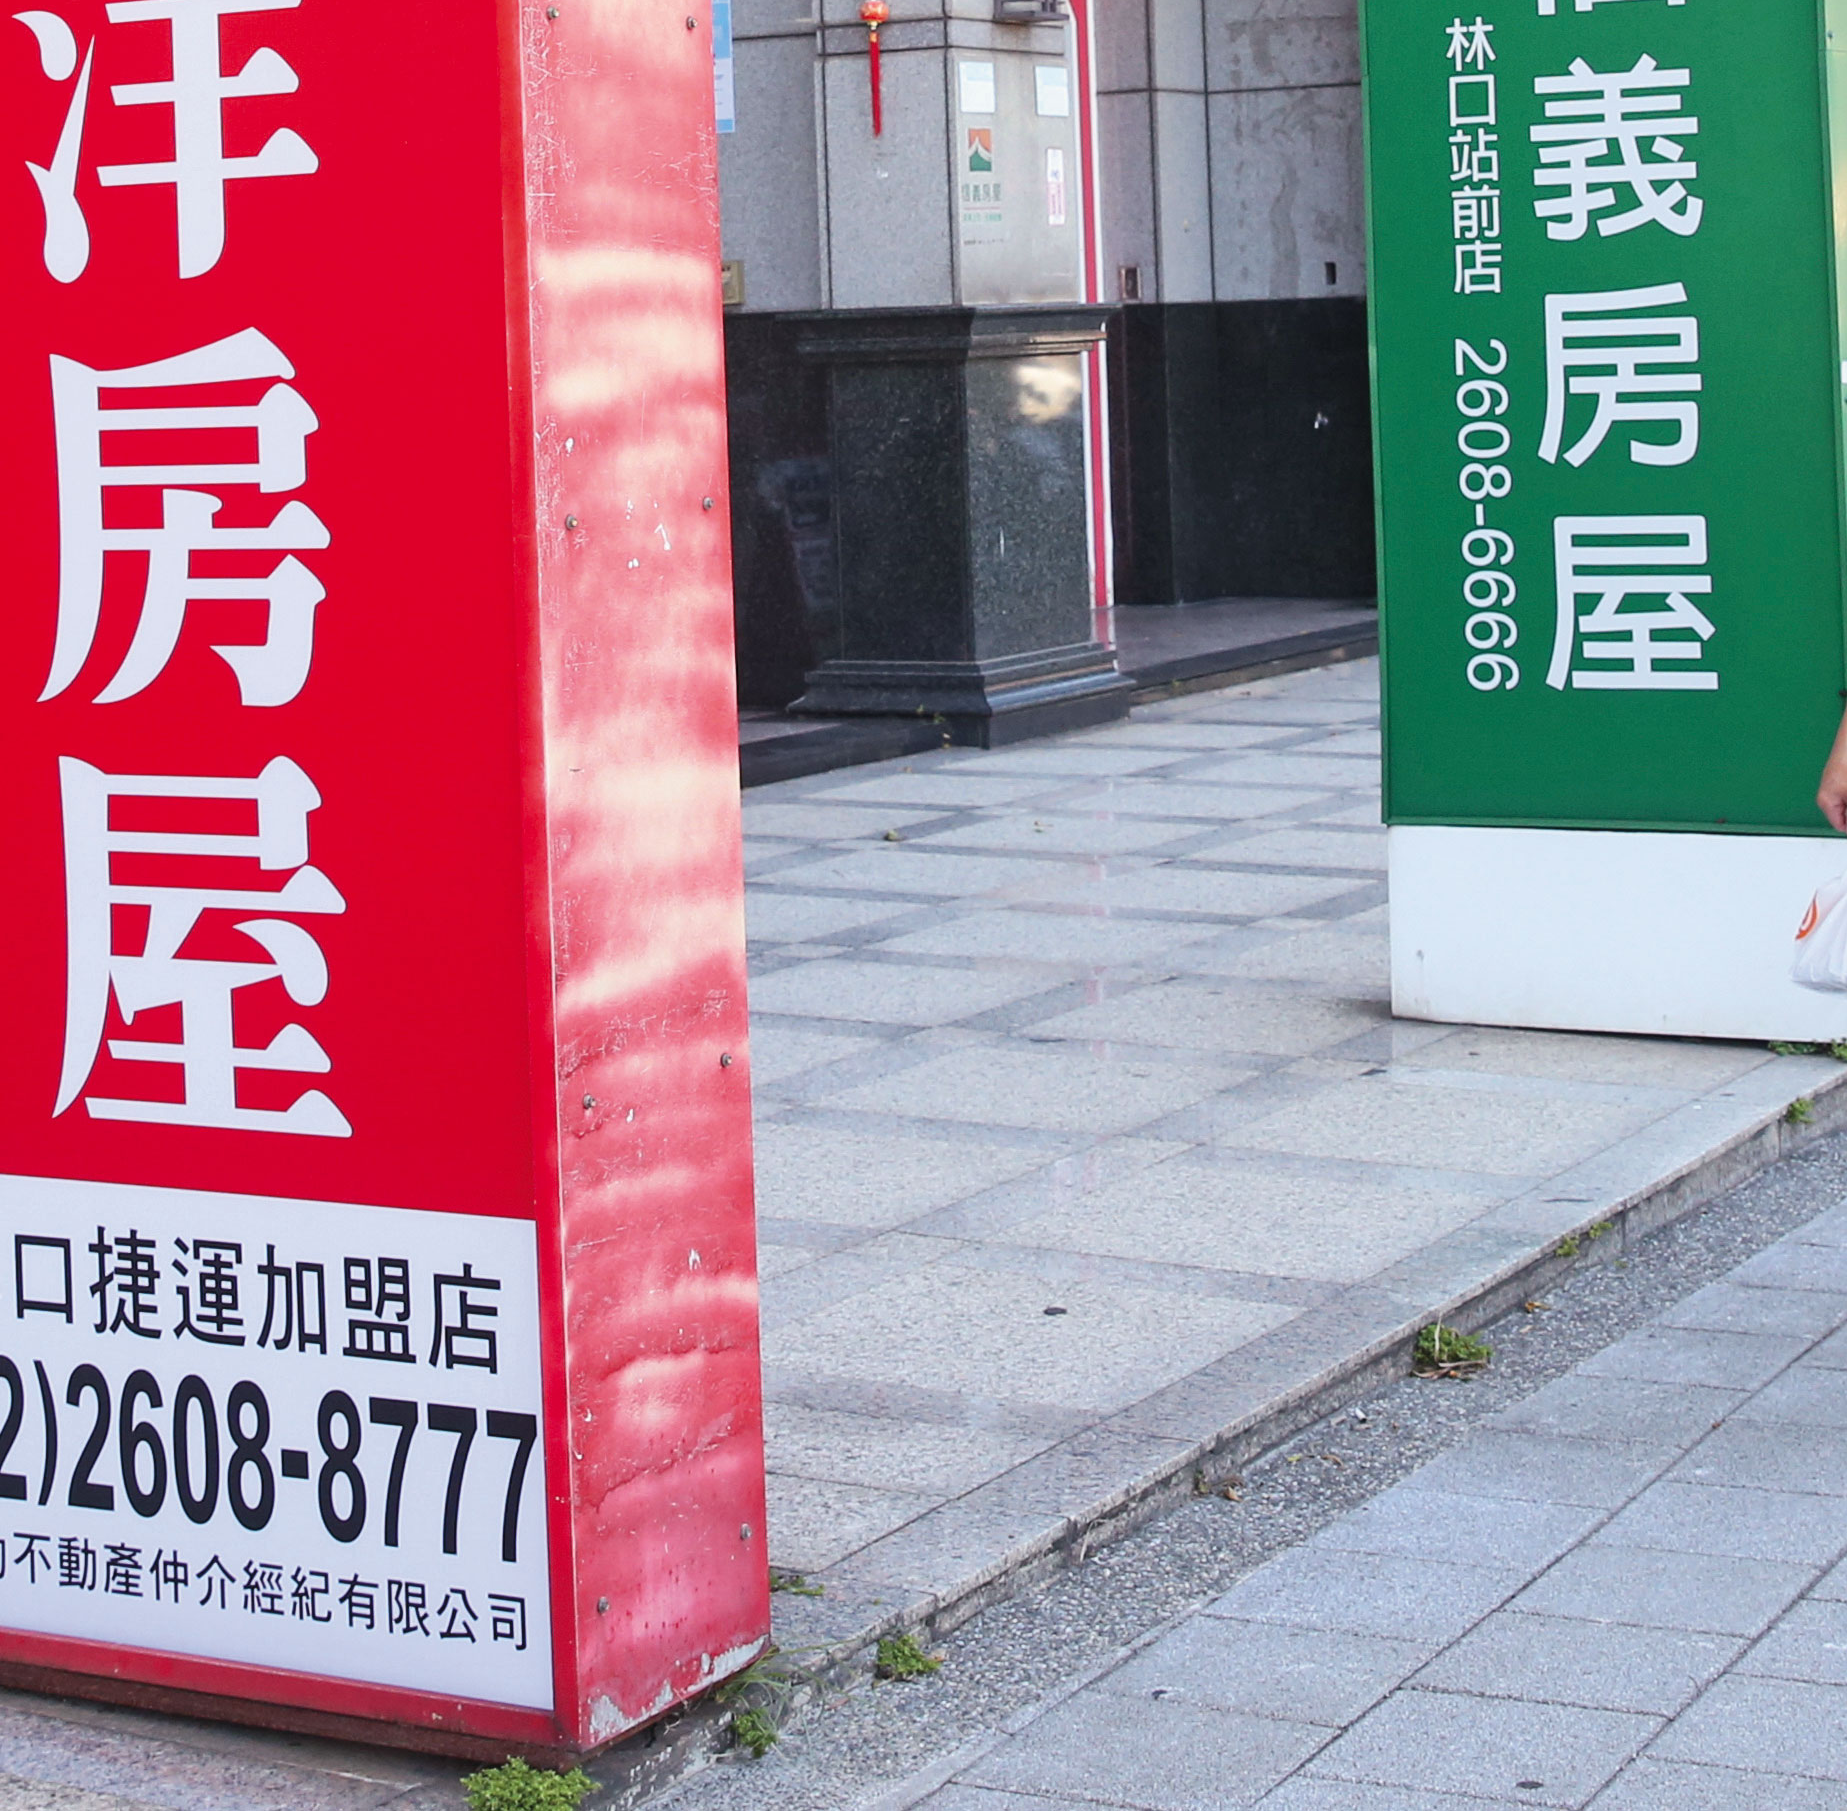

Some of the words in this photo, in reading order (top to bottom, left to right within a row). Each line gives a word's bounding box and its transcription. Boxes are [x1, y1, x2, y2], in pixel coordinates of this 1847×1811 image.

[1443, 15, 1503, 295] 林口站前店
[1453, 336, 1520, 693] 2608-6666
